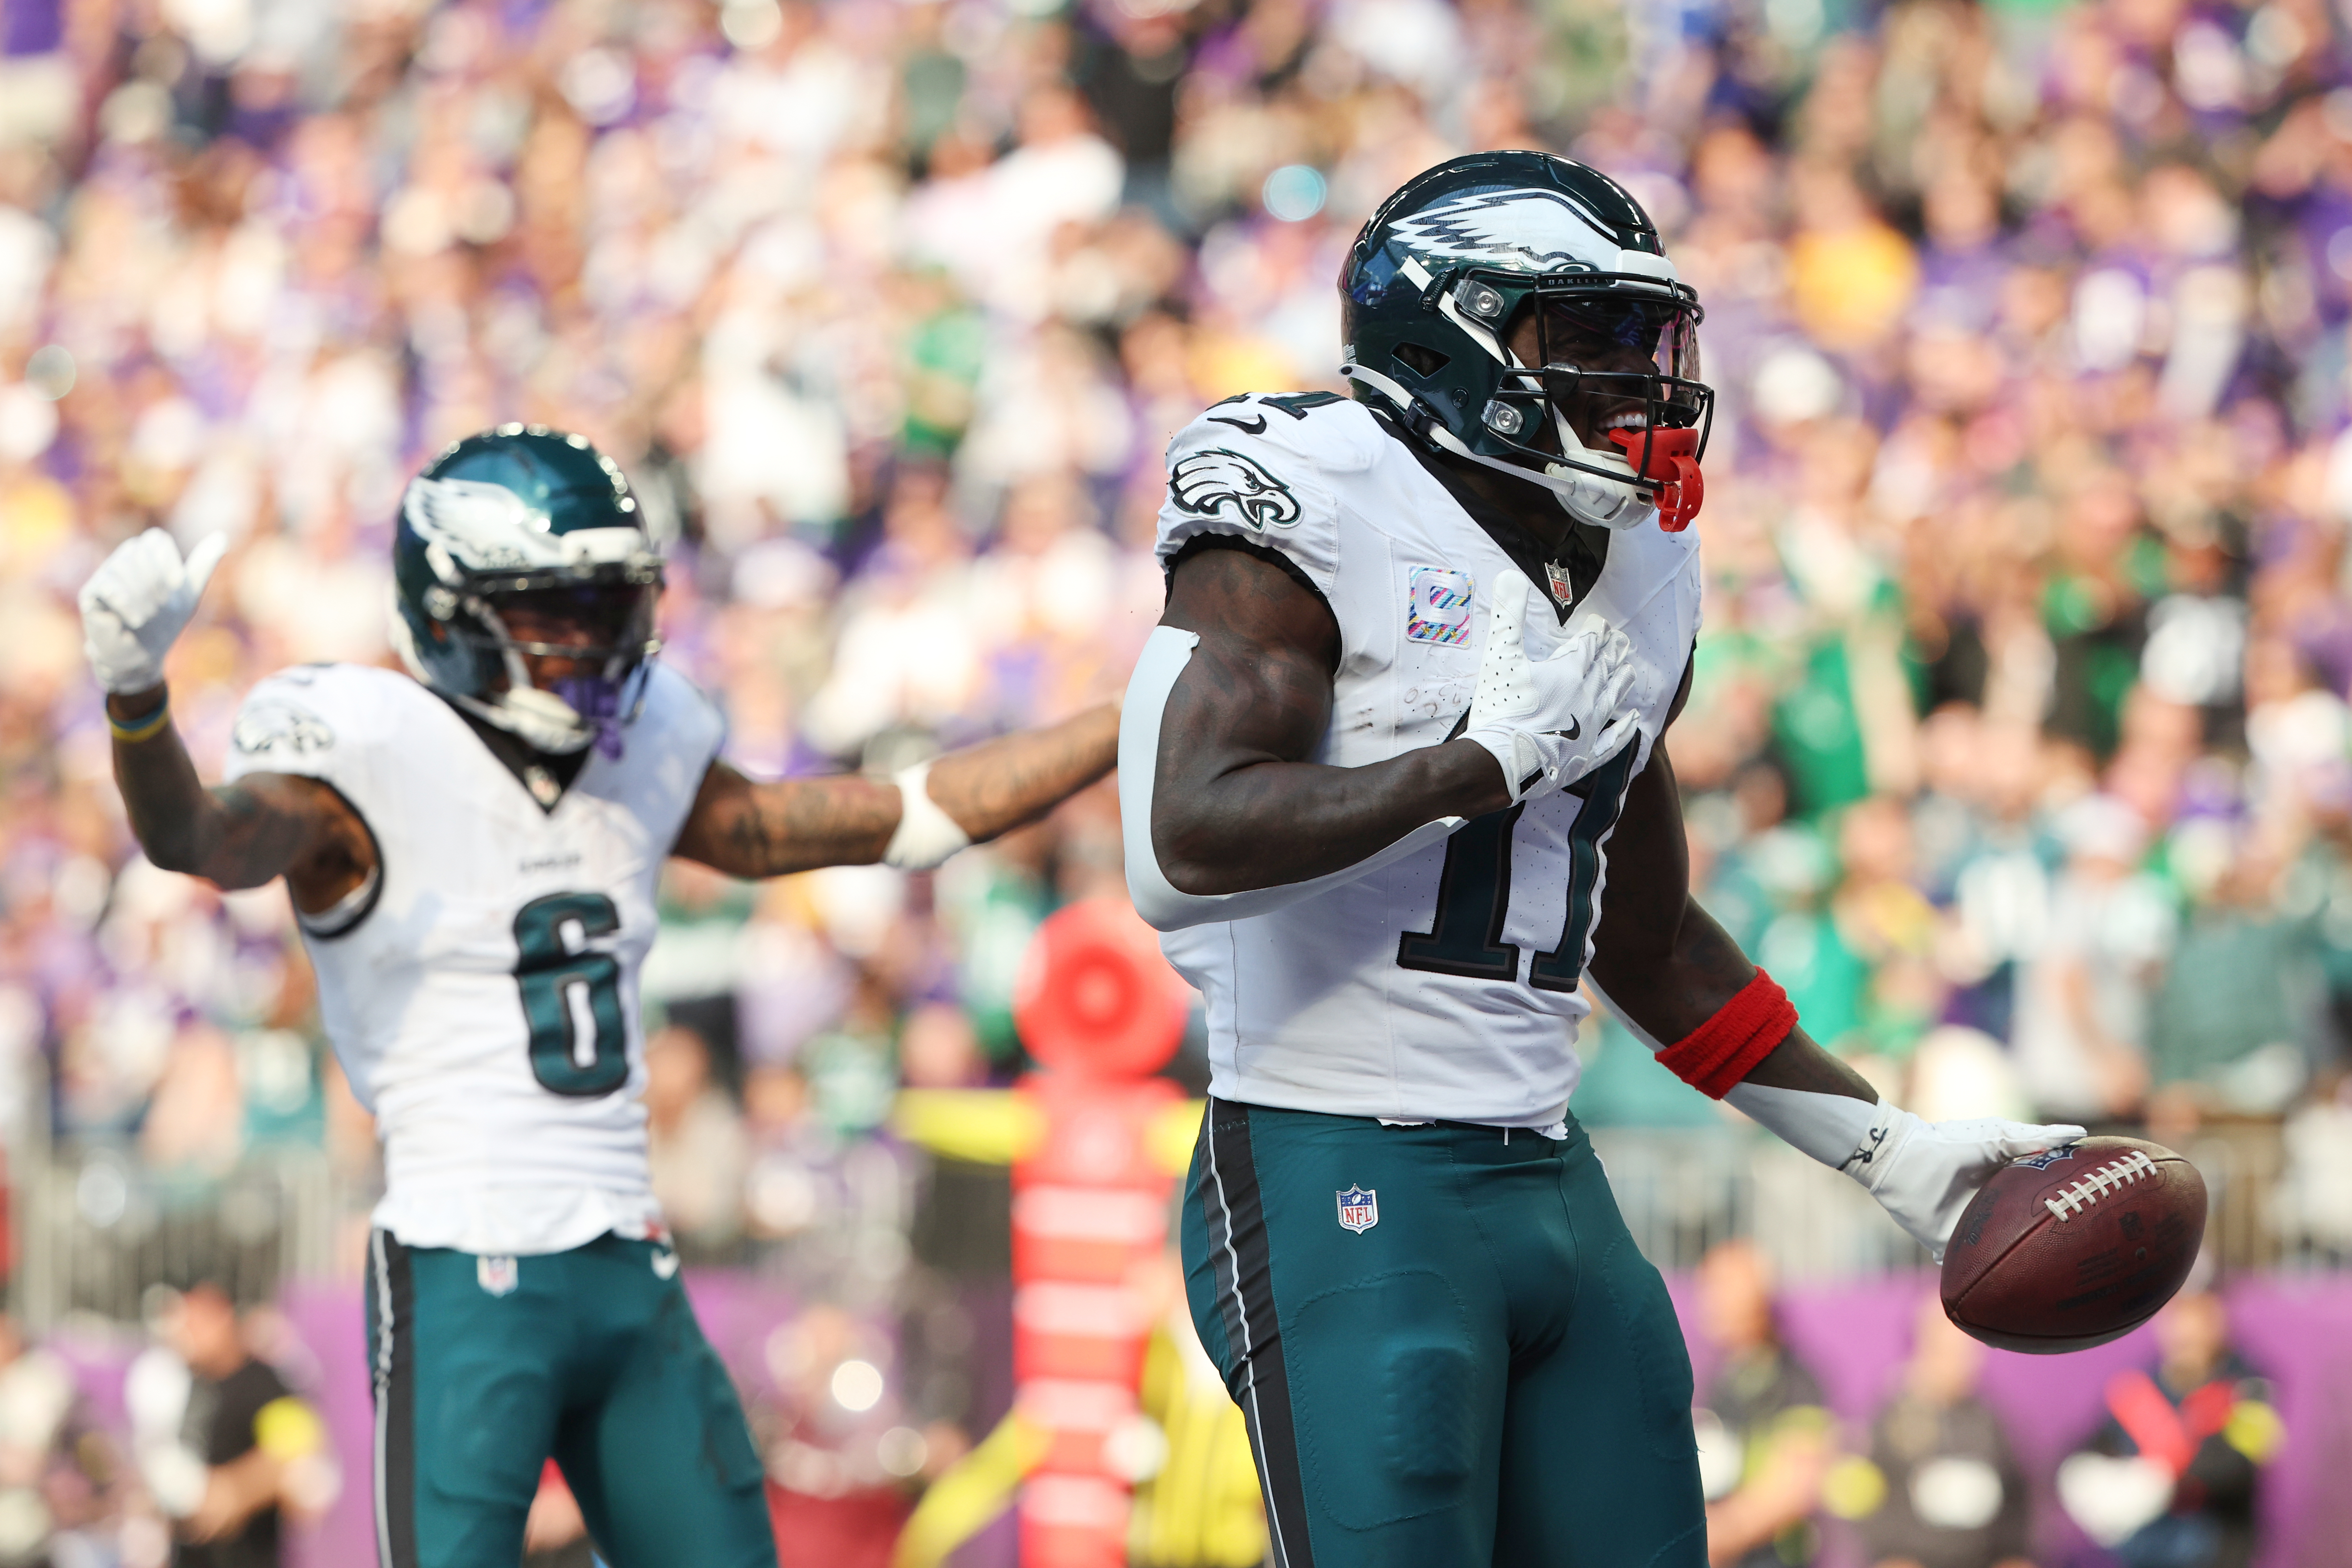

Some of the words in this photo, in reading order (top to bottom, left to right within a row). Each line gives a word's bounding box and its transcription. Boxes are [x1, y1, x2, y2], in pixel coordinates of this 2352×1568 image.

[1414, 570, 1469, 626] C
[1552, 580, 1570, 599] NFL
[1396, 703, 1642, 993] 11
[512, 891, 630, 1096] 6
[1344, 1207, 1372, 1225] NFL
